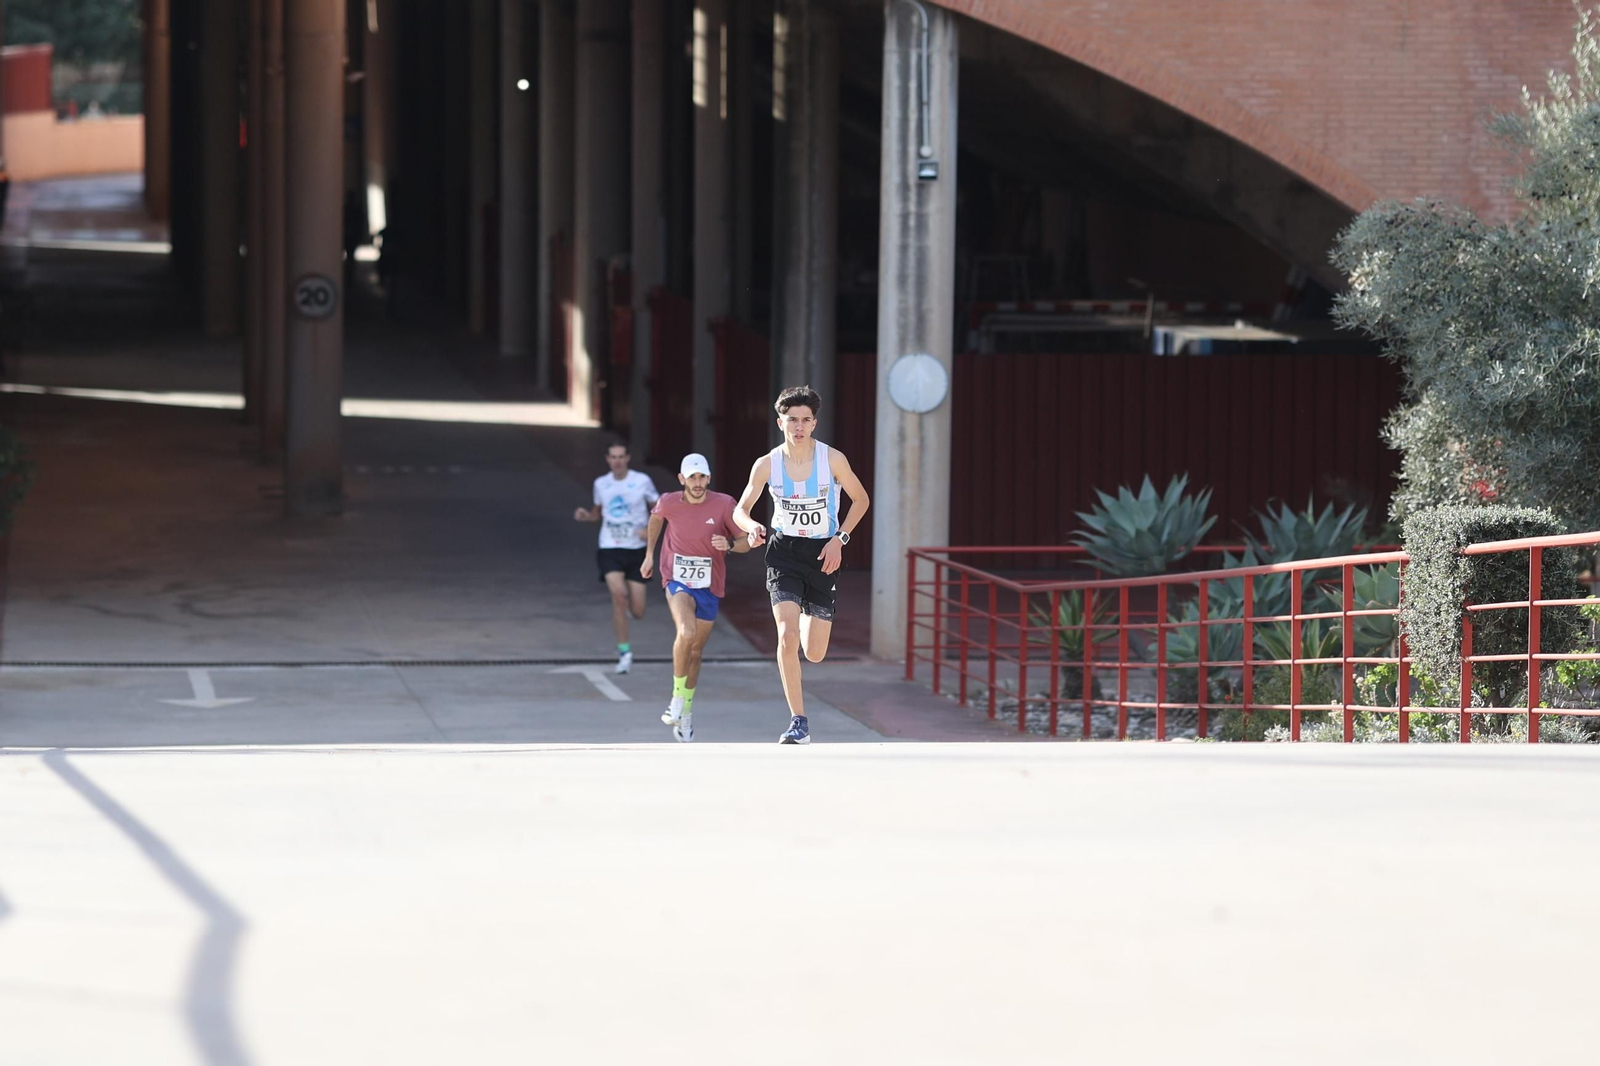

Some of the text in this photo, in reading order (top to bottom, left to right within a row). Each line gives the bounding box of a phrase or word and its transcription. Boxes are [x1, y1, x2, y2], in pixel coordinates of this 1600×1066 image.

[299, 286, 329, 307] 20
[783, 503, 803, 511] UMA
[789, 512, 821, 526] 700
[680, 567, 705, 579] 276
